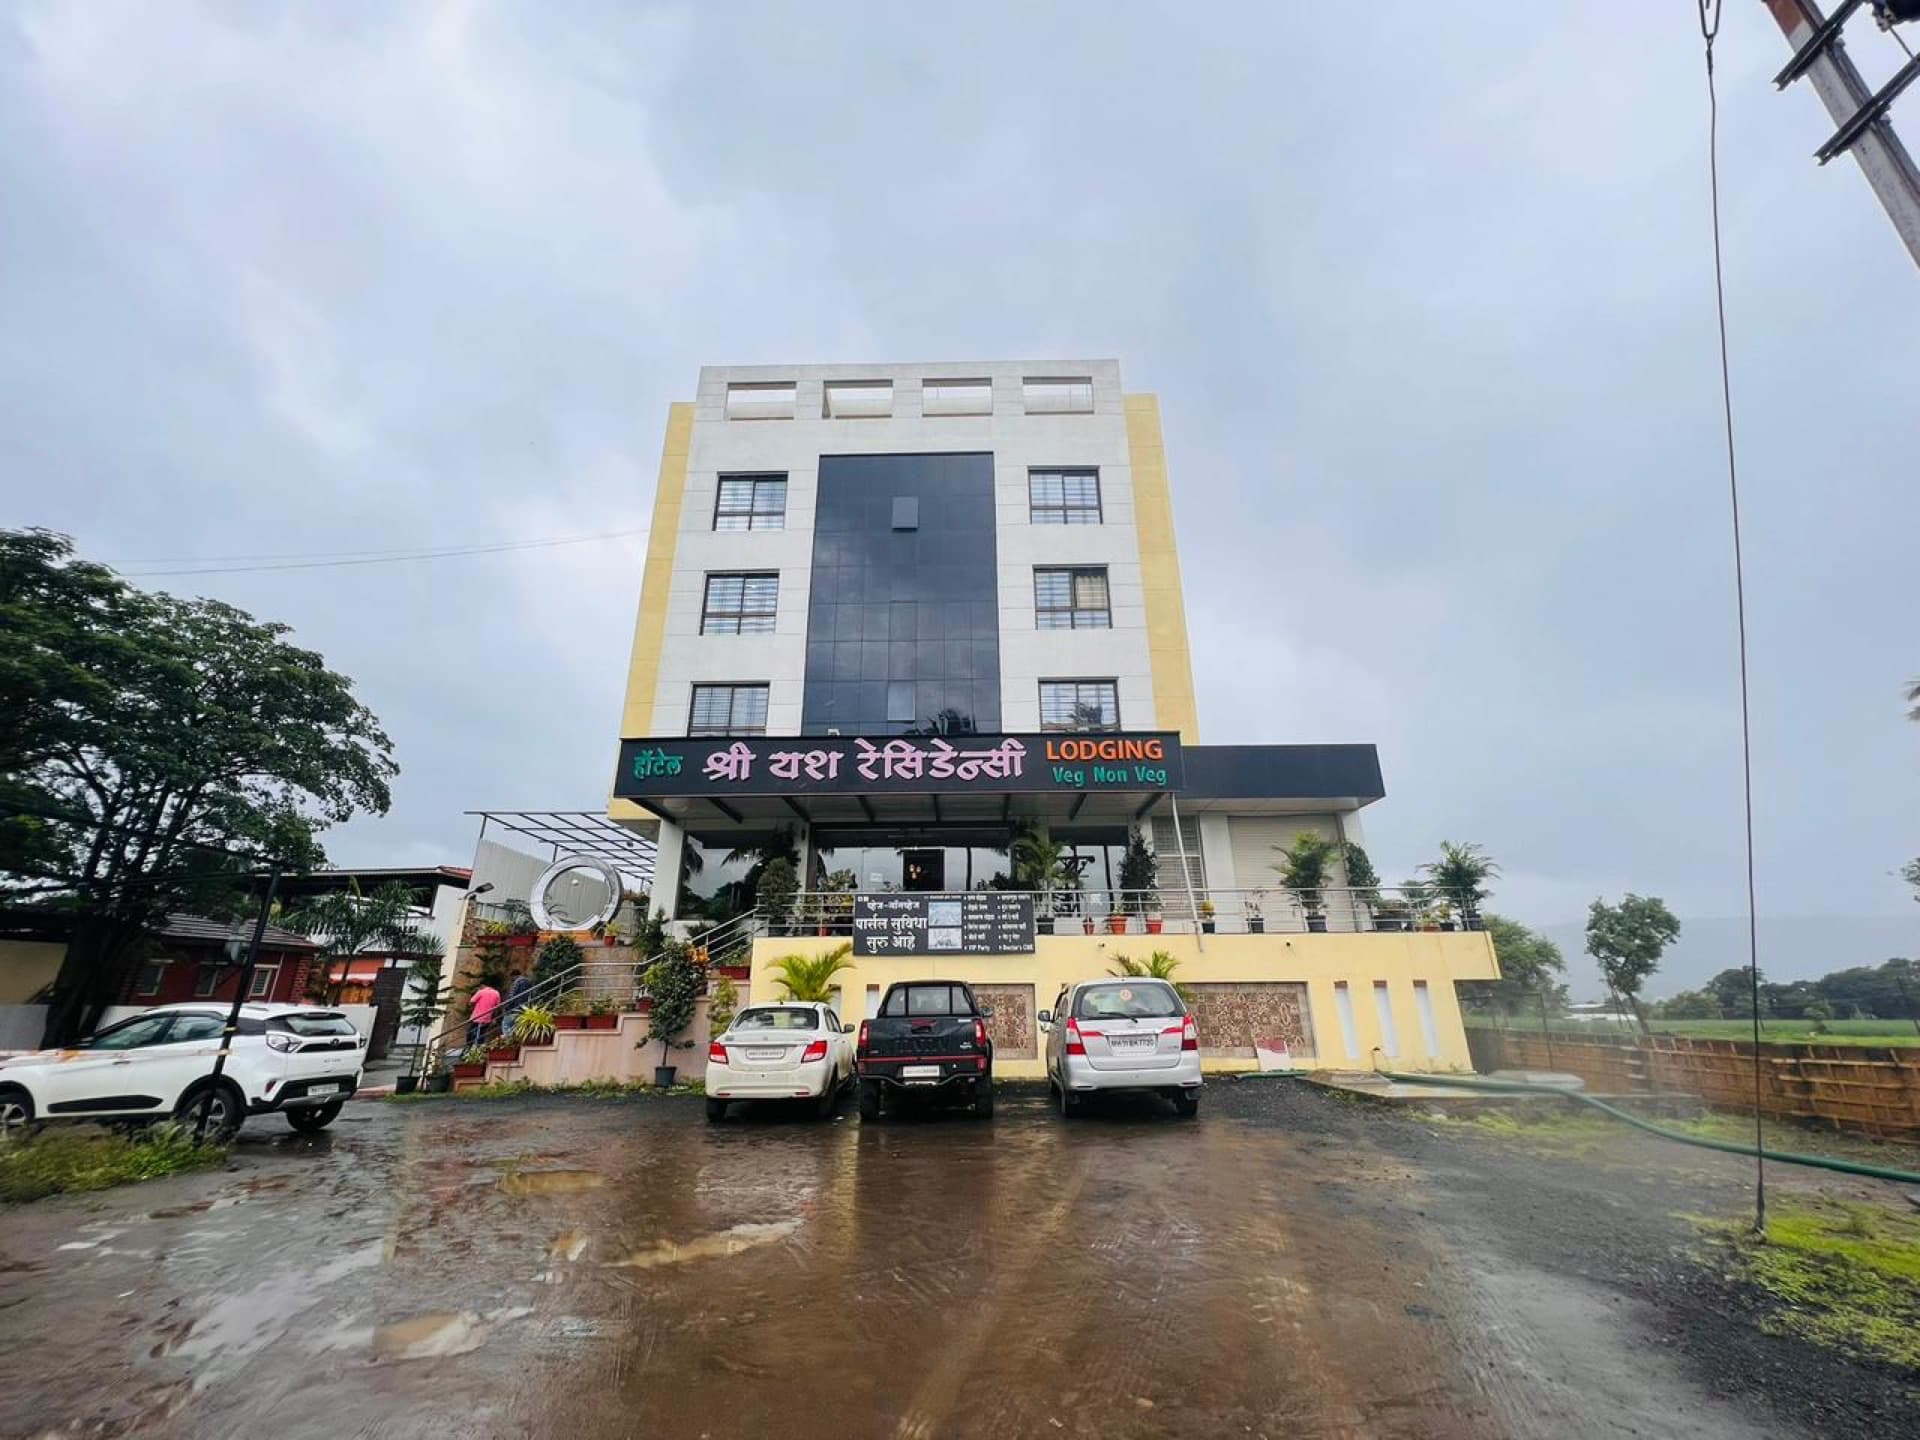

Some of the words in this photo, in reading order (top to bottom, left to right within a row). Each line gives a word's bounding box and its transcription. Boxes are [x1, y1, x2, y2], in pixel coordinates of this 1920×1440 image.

[633, 747, 684, 779] हॉटेल
[702, 741, 757, 781] श्री
[769, 750, 845, 780] यश
[854, 737, 1027, 781] रेसिडेन्सी
[1045, 739, 1163, 760] LODGING
[1052, 766, 1085, 787] Veg
[1093, 766, 1128, 782] Non
[1134, 765, 1167, 786] Veg
[855, 913, 888, 930] पार्सल
[890, 913, 928, 936] सुविधा
[892, 931, 916, 951] आहे
